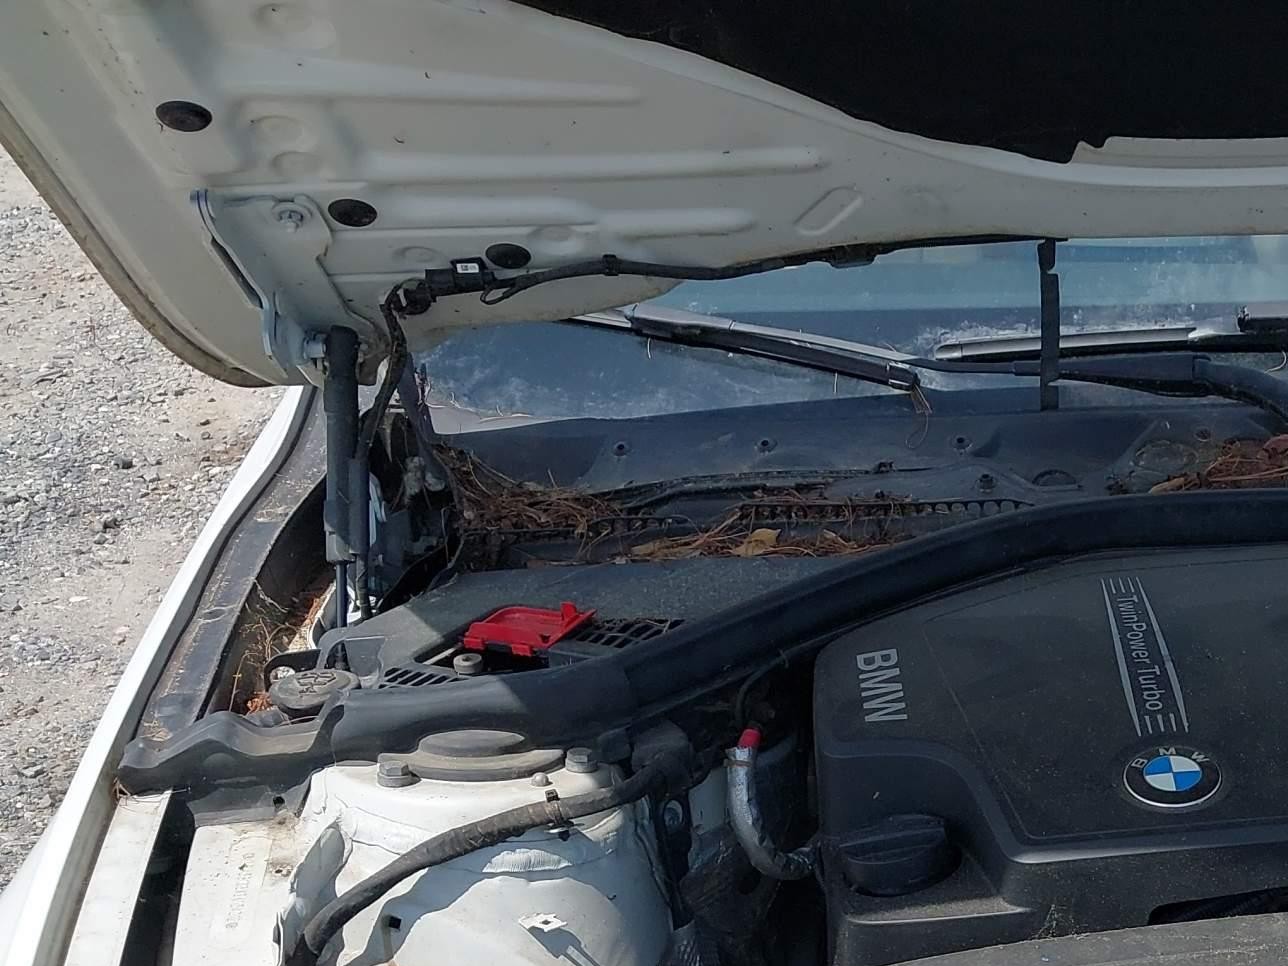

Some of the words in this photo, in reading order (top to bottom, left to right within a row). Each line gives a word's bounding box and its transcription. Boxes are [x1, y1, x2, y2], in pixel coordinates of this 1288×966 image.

[857, 648, 908, 723] BMW
[1117, 595, 1152, 664] TwinPower
[1137, 664, 1166, 711] Turbo
[1130, 746, 1211, 769] BMW
